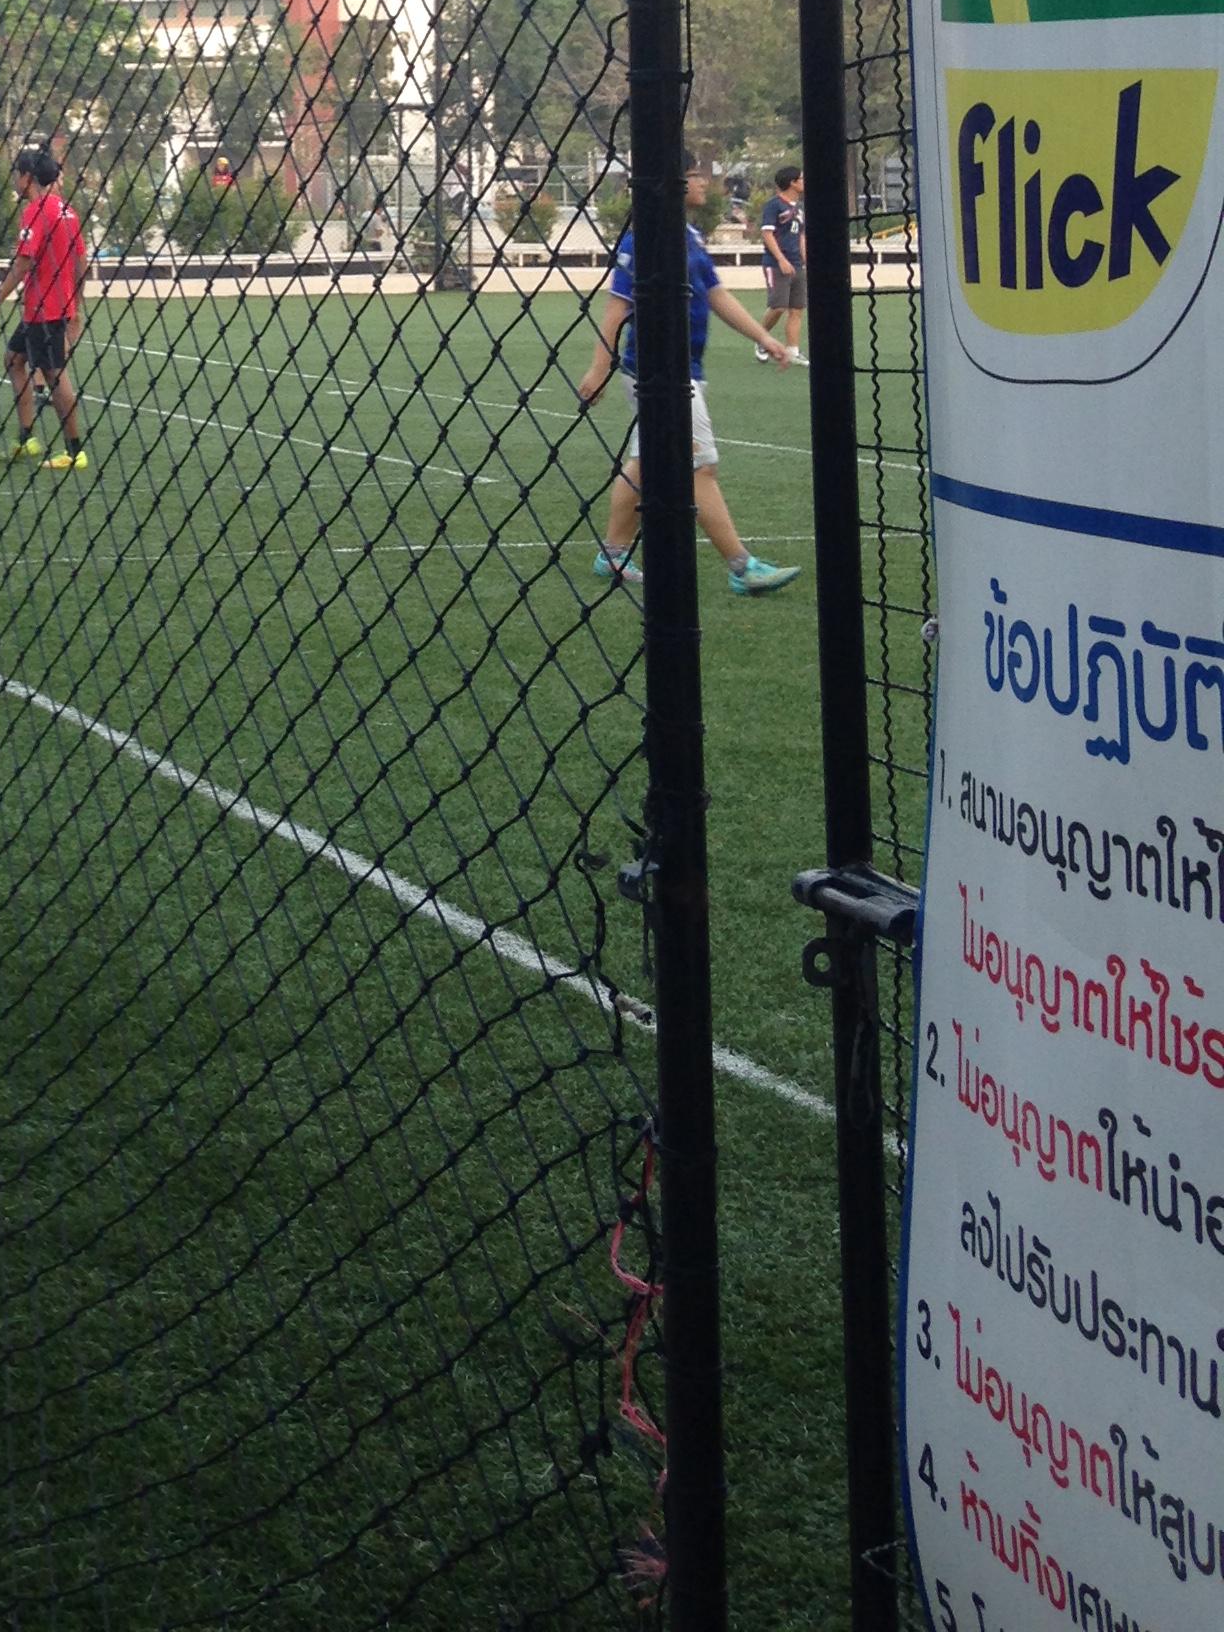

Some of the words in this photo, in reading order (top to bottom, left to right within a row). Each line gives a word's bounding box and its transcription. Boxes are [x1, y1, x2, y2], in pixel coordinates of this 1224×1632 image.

[957, 79, 1182, 290] flick
[926, 1021, 946, 1087] 2.
[960, 1189, 1224, 1418] ลงไปรับประทาน
[916, 1299, 941, 1370] 3.
[947, 1300, 1224, 1582] ไม่อนุญาตให้สูบ
[918, 1442, 947, 1512] 4.
